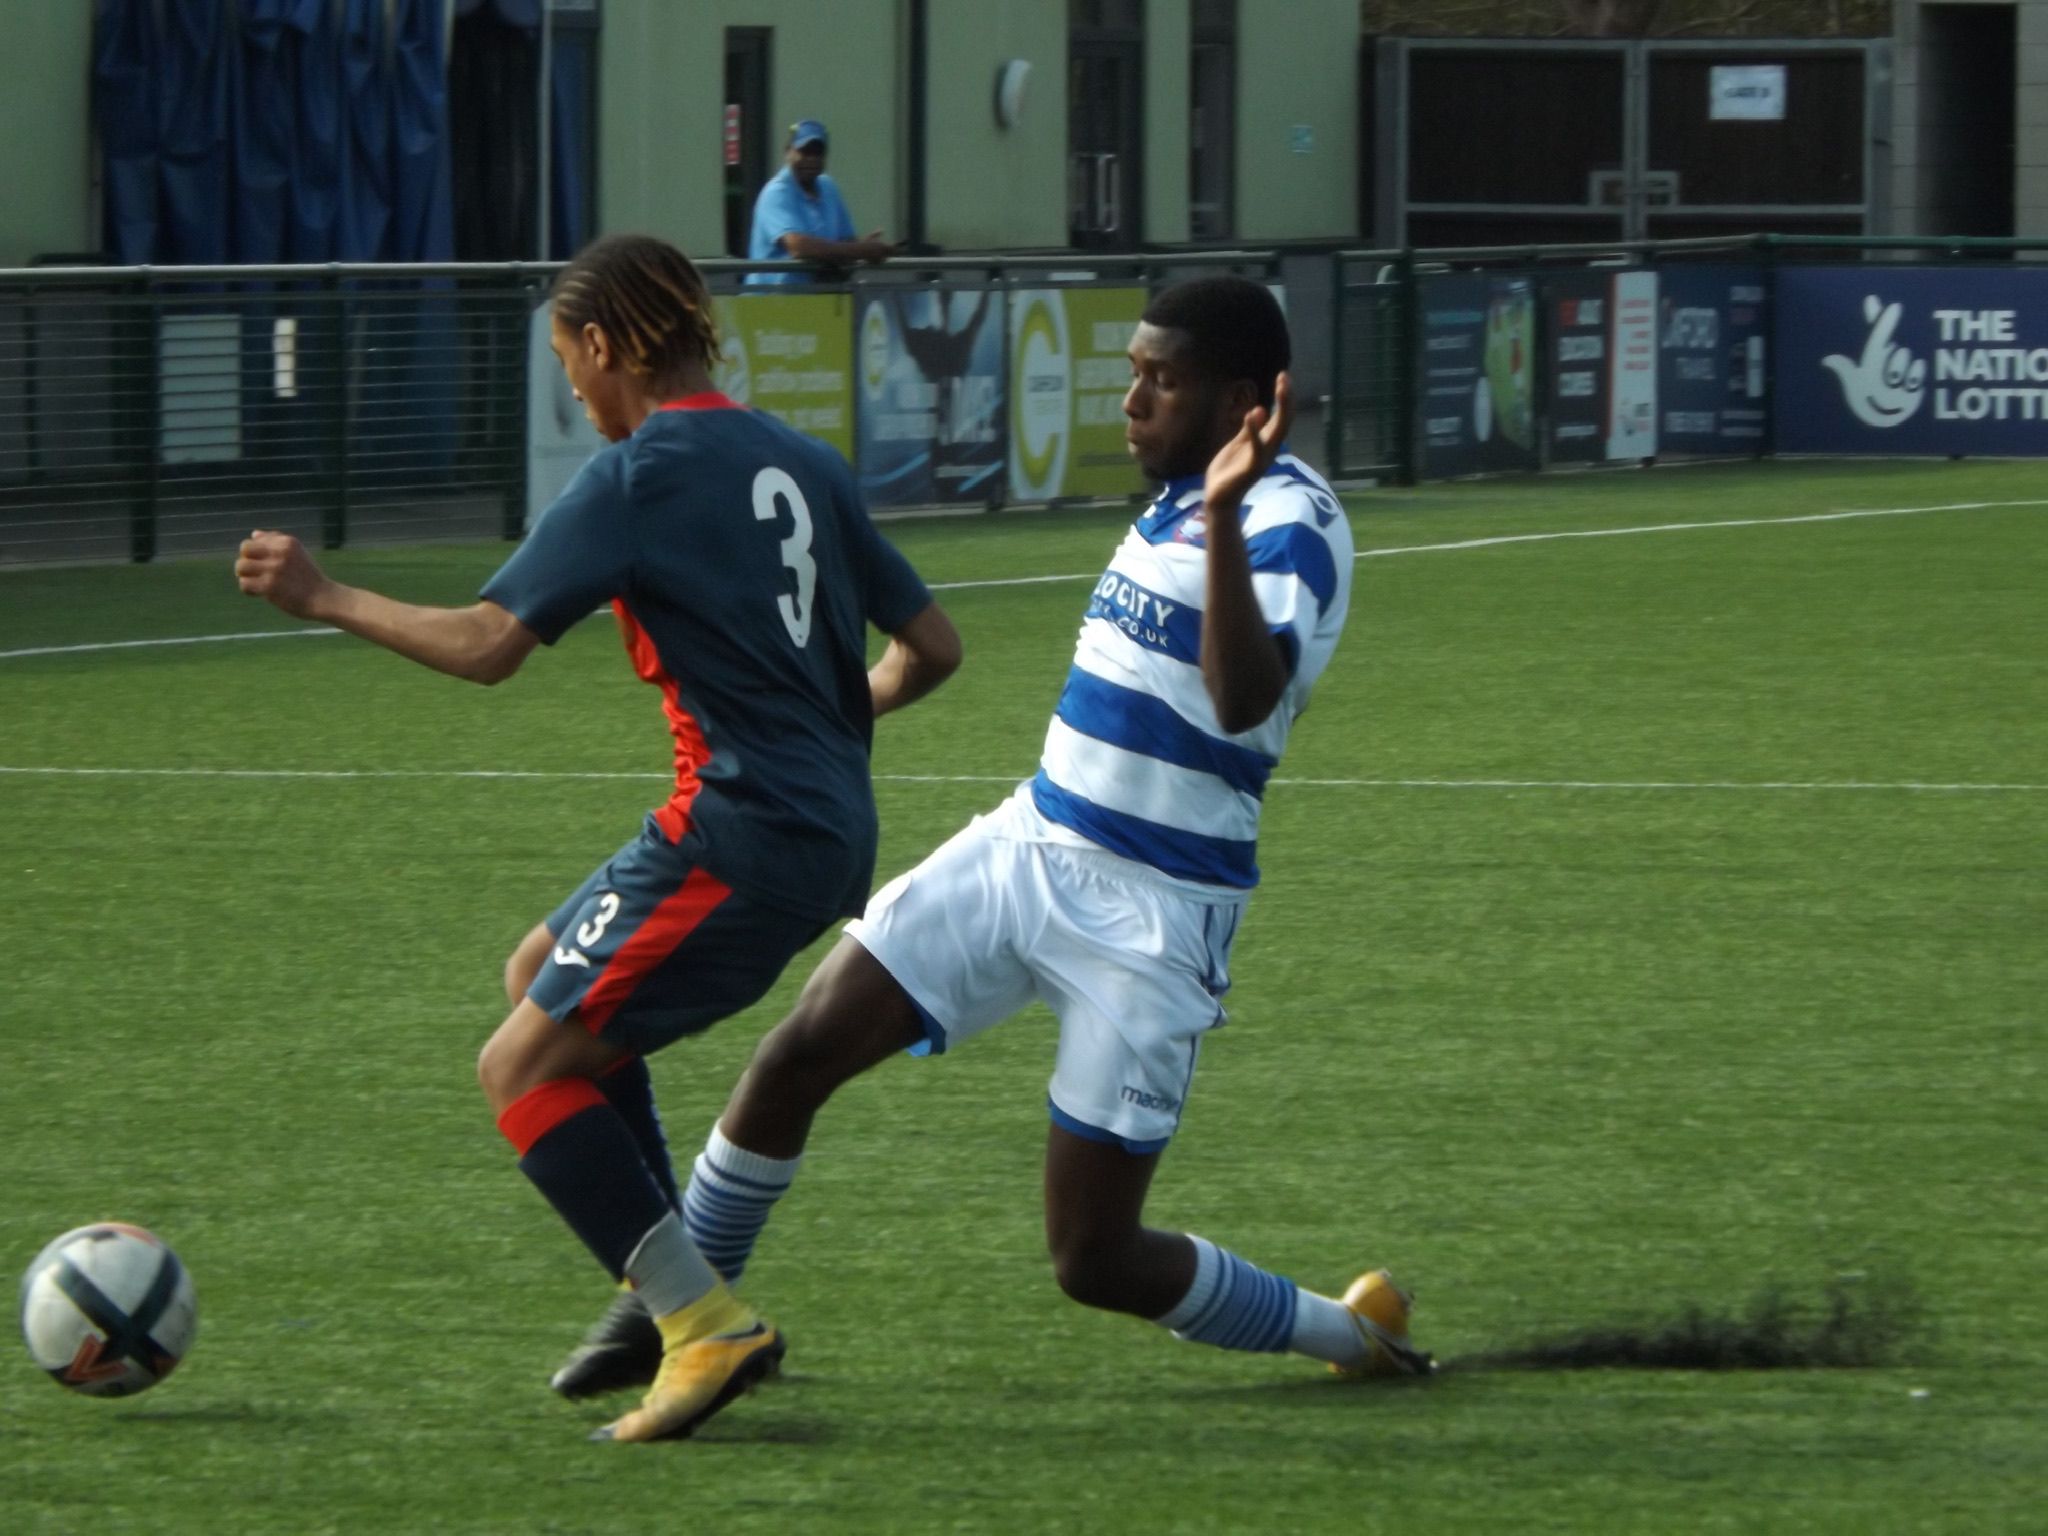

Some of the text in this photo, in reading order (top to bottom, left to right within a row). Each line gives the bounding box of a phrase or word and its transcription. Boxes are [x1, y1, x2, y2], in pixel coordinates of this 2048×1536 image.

[1933, 310, 2017, 341] THE
[752, 466, 817, 648] 3
[576, 892, 620, 947] 3
